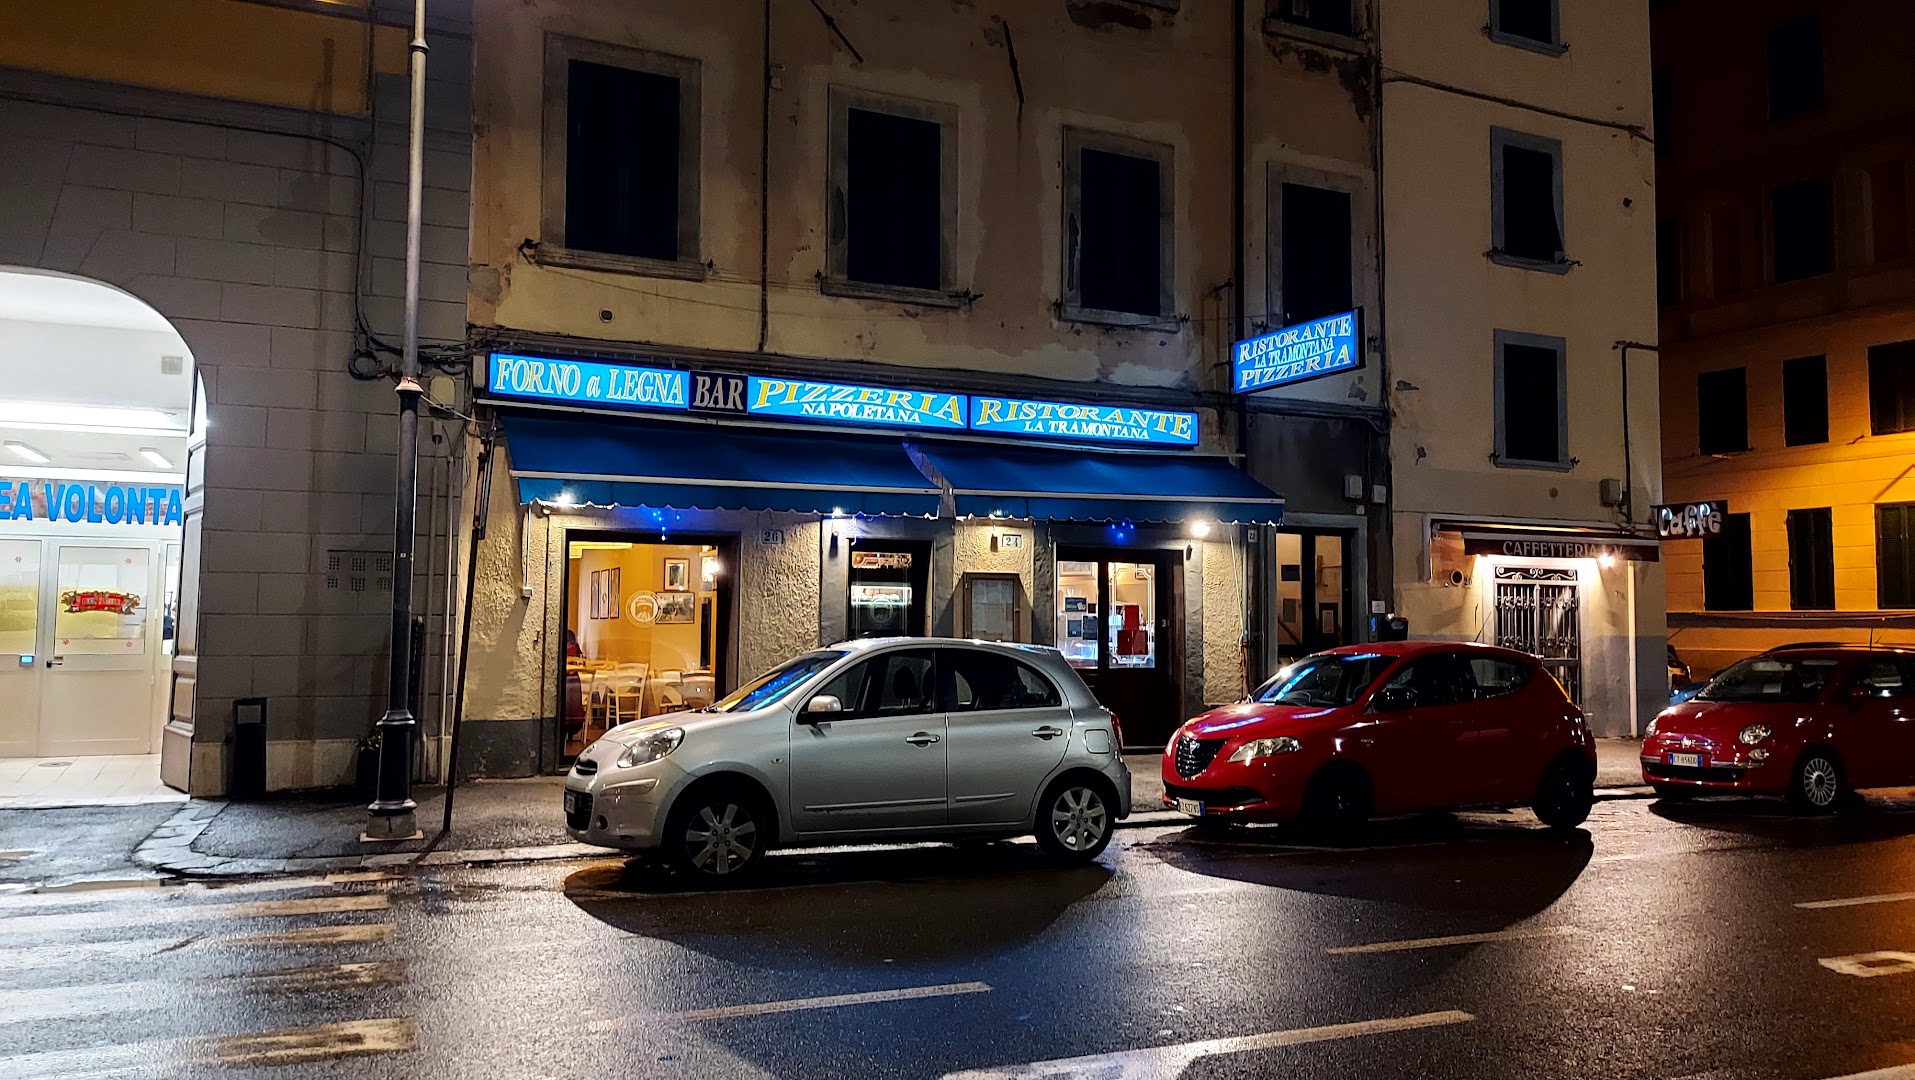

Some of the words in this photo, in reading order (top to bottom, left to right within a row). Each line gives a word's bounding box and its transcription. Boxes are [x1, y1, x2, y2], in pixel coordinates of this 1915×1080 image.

[1238, 314, 1352, 365] RISTORANTE
[1253, 355, 1265, 368] LA
[1268, 337, 1335, 366] TRAMONTANA
[494, 358, 581, 396] FORNO
[586, 375, 601, 398] a
[606, 369, 685, 404] LEGNA
[1239, 344, 1352, 389] PIZZERIA
[693, 376, 744, 410] BAR
[751, 379, 965, 426] PIZZERIA
[801, 402, 921, 423] NAPOLETANA
[976, 399, 1192, 441] RISTORANTE
[1023, 420, 1045, 433] LA
[1049, 420, 1150, 440] TRAMONTANA
[45, 484, 182, 526] VOLONTA
[764, 531, 779, 542] 26
[1502, 541, 1597, 558] CAFFETTERIA
